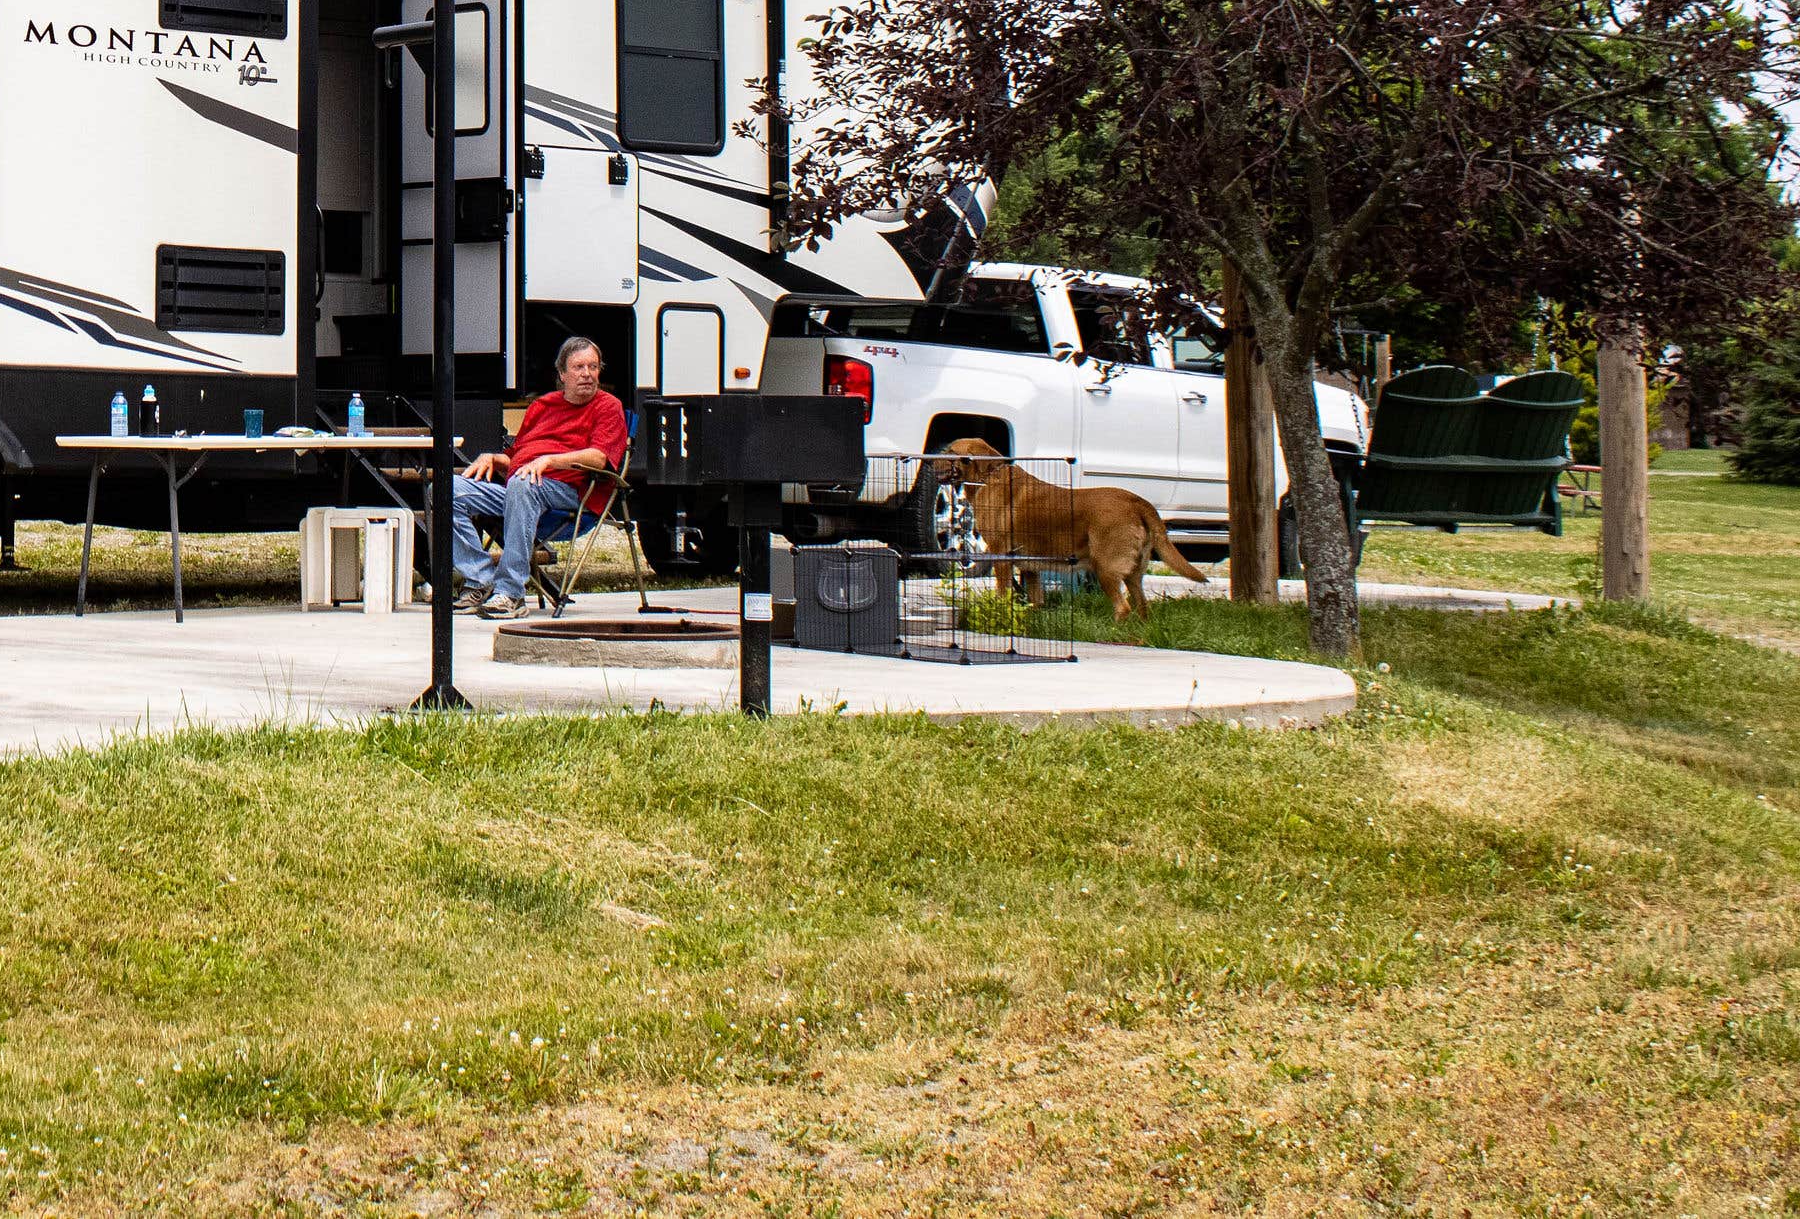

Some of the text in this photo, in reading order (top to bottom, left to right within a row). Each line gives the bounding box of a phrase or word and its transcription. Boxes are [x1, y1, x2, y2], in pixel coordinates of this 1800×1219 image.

[24, 20, 267, 63] MONTANA
[84, 52, 222, 73] HIGH COUNTRY
